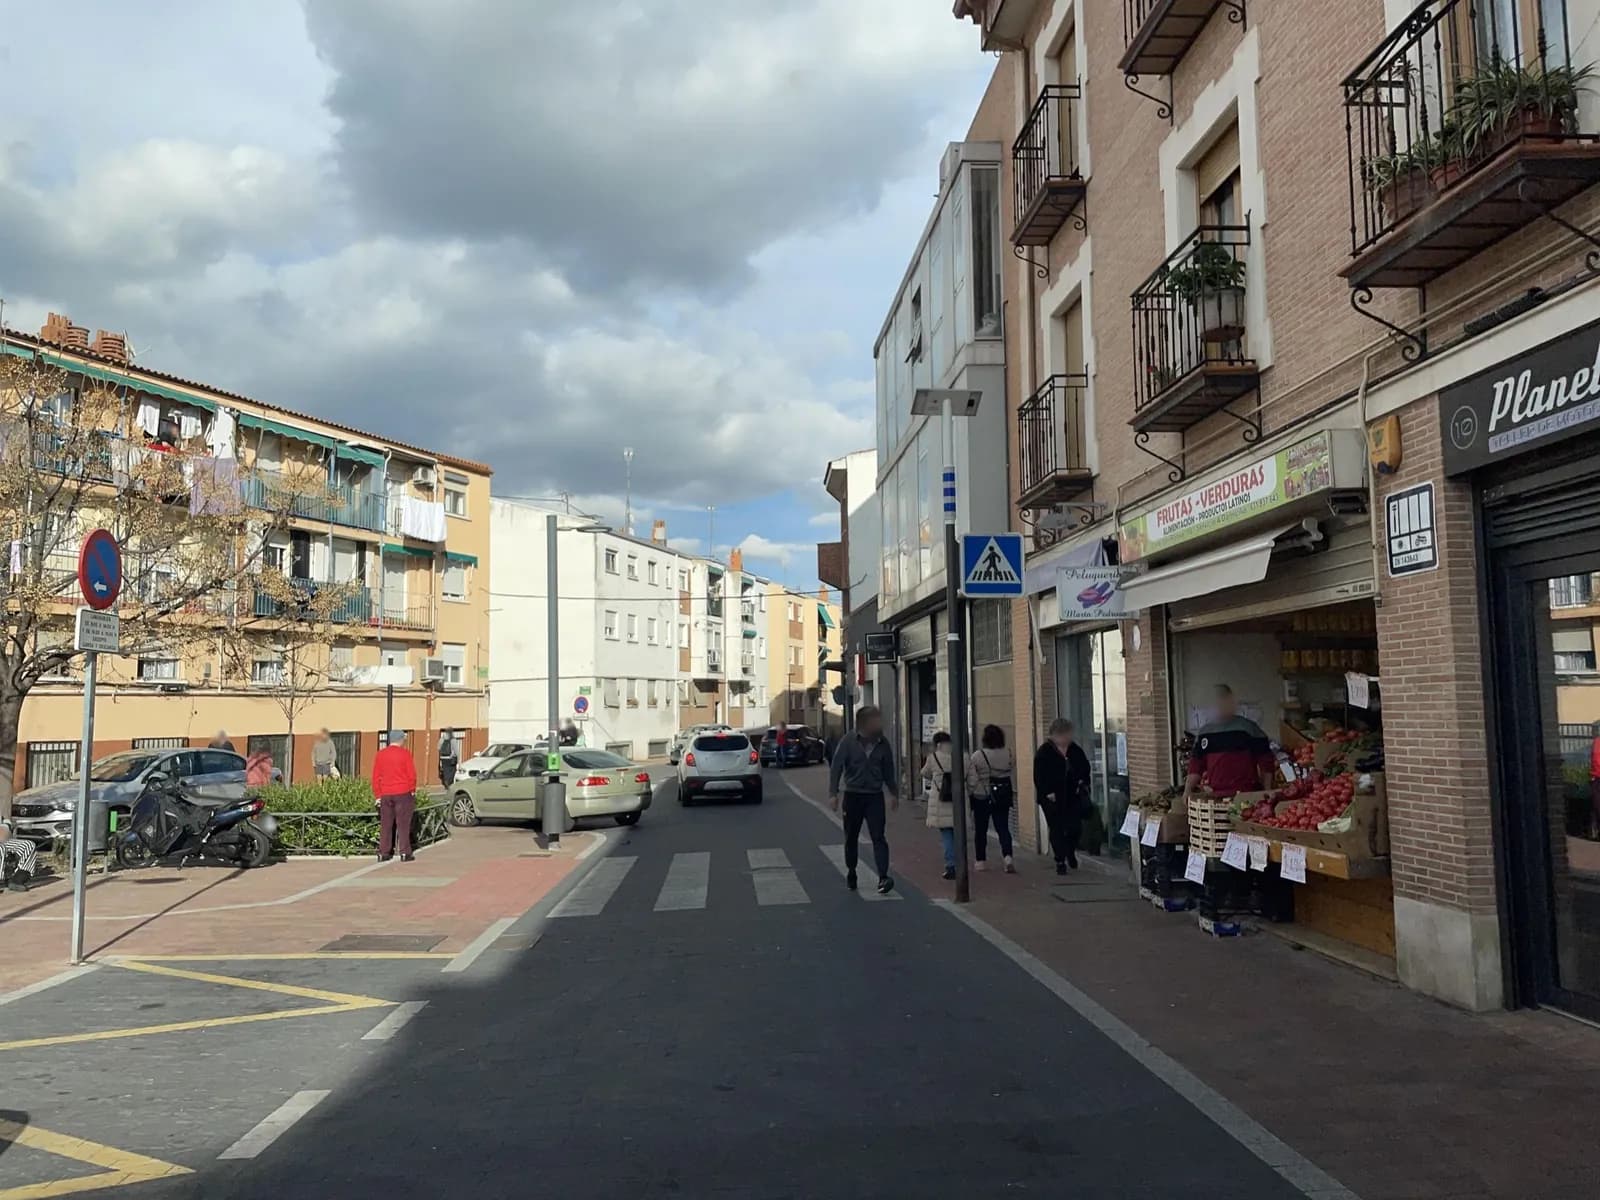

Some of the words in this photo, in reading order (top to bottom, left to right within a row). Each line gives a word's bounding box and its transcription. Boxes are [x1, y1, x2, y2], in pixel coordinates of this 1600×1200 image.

[1156, 496, 1193, 528] FRUTAS
[1198, 502, 1228, 521] PRODUCTOS
[1228, 492, 1251, 510] LATINOS
